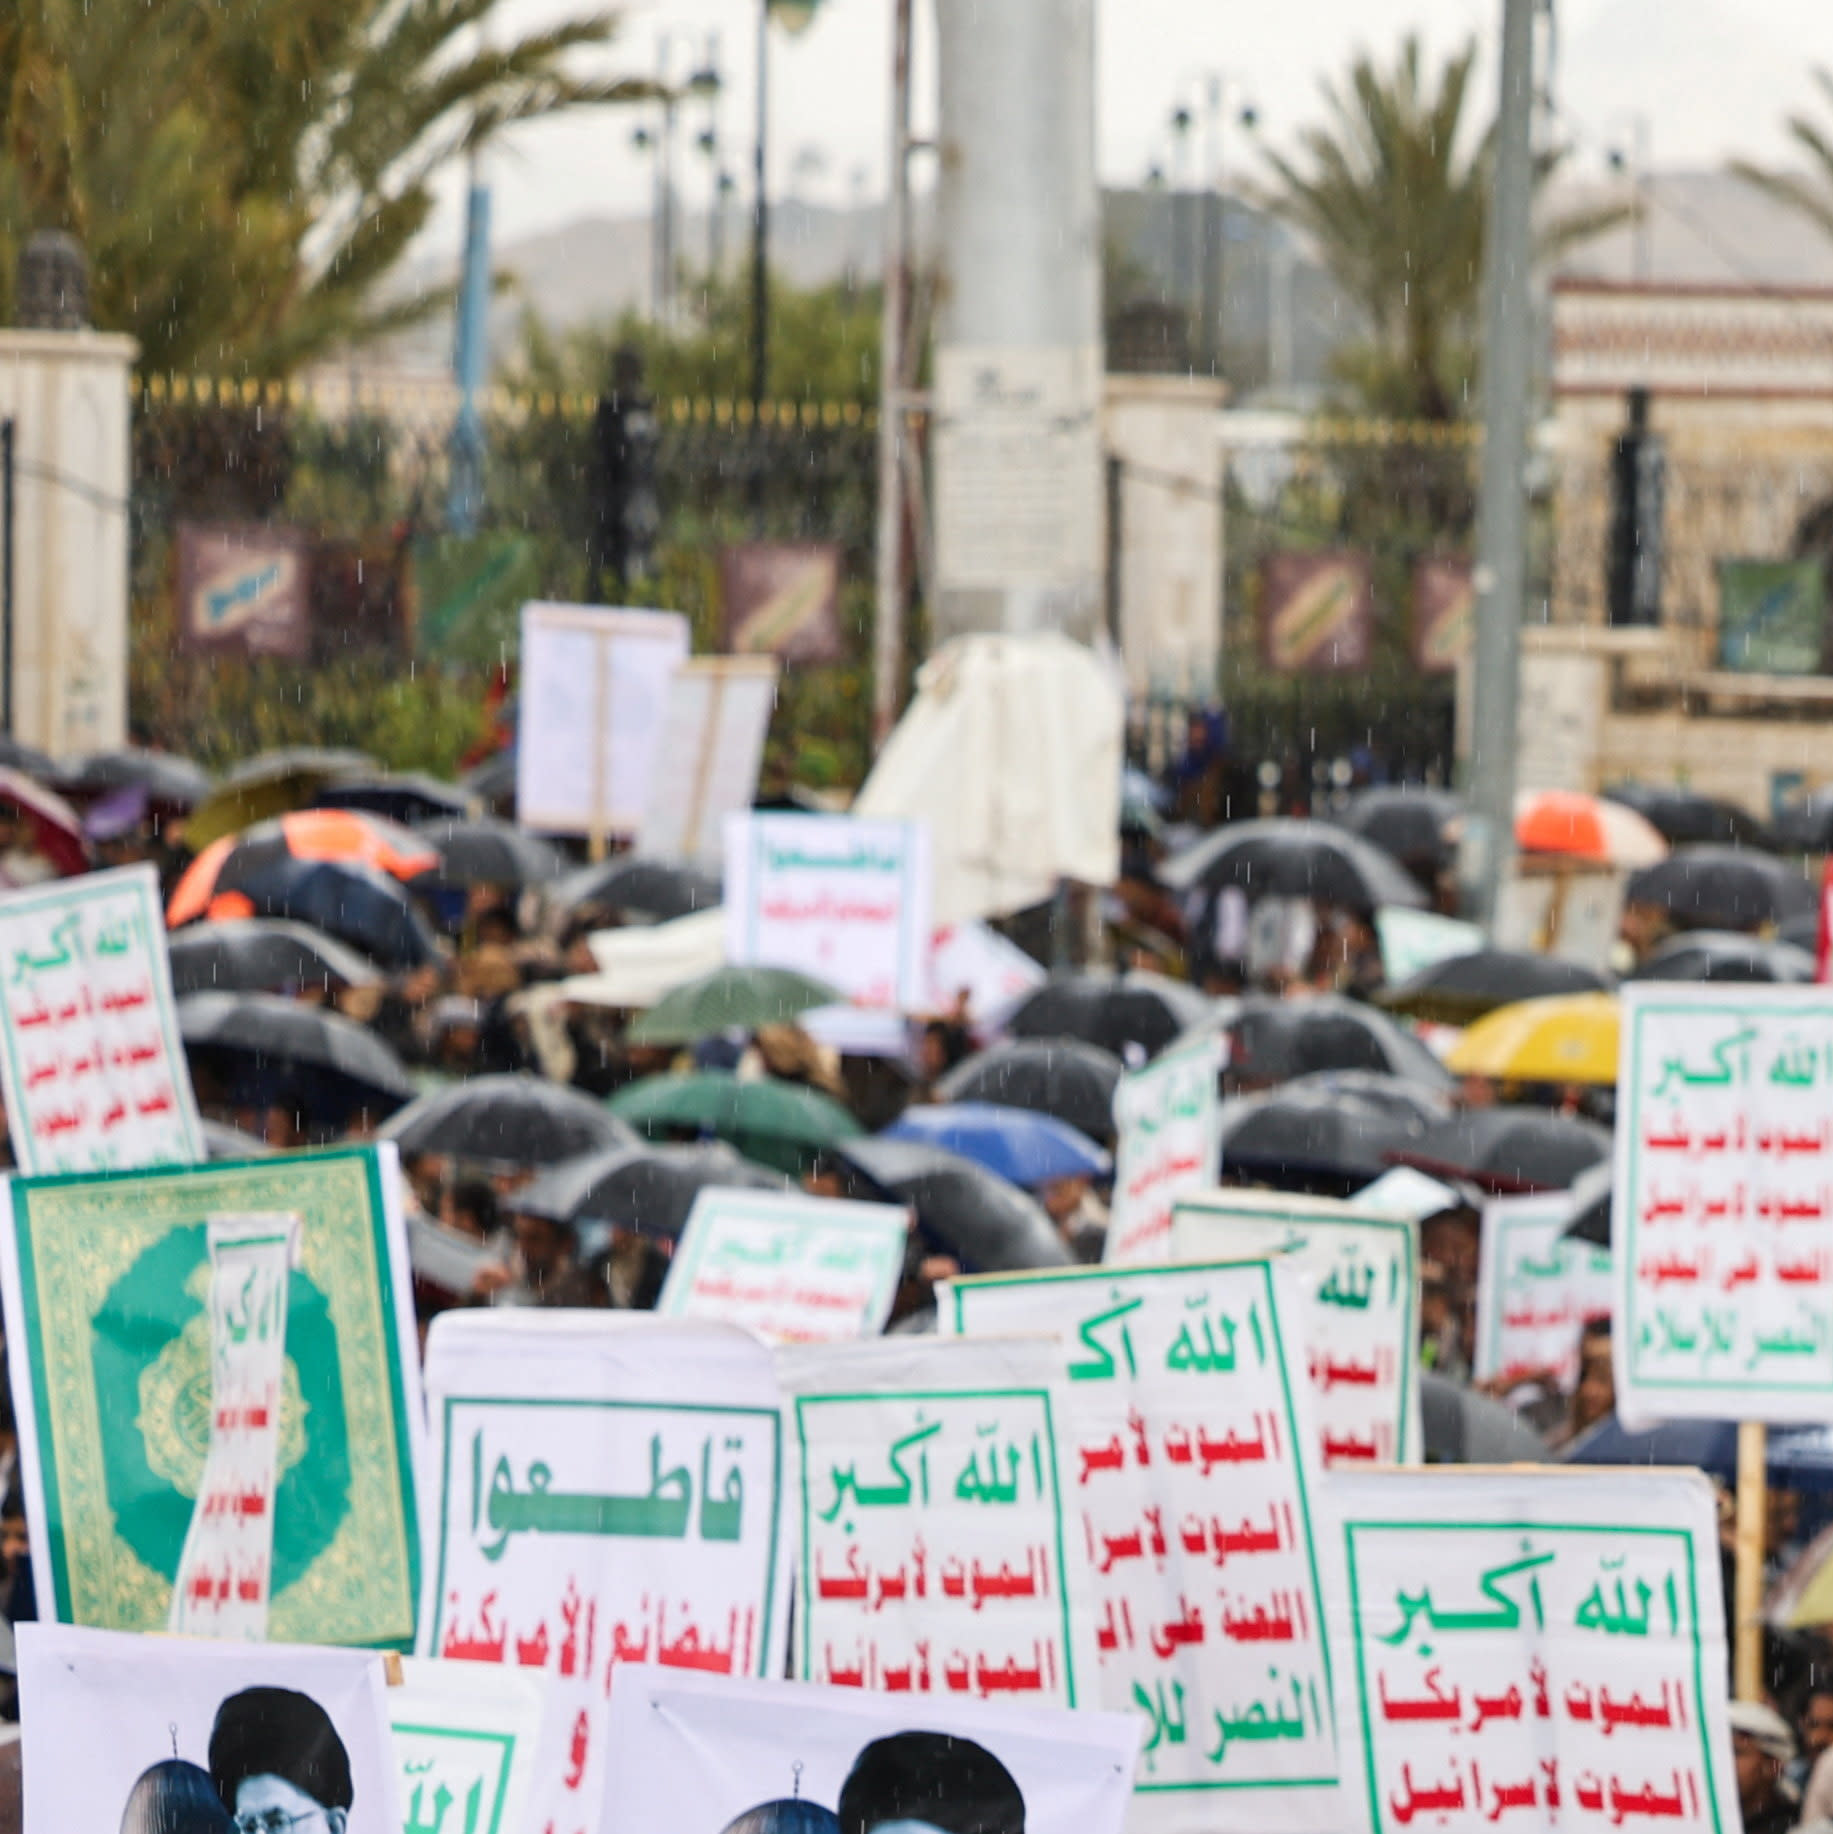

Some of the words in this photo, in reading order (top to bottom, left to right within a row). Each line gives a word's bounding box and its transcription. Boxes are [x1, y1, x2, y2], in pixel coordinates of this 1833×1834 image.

[1650, 1028, 1758, 1104] أكبر
[1316, 1248, 1400, 1312] الله
[1067, 1288, 1144, 1382] أك
[1165, 1296, 1267, 1374] الله
[818, 1413, 943, 1535] أكبر
[954, 1424, 1044, 1504] الله
[1077, 1408, 1153, 1487] لأمر
[1162, 1411, 1282, 1478] الموت
[472, 1430, 744, 1563] قاطعوا
[1085, 1506, 1170, 1576] لإسرا
[1178, 1502, 1297, 1568] الموت
[816, 1536, 929, 1613] لأمريكا
[940, 1546, 1050, 1613] الموت
[1376, 1540, 1557, 1659] أكبر
[1574, 1558, 1680, 1638] الله
[1149, 1596, 1207, 1662] على
[1220, 1592, 1308, 1644] اللعنة
[942, 1640, 1057, 1700] الموت
[1378, 1656, 1554, 1735] لأمريكا
[1206, 1667, 1321, 1765] النصر
[1563, 1680, 1688, 1737] الموت
[563, 1709, 590, 1792] و
[1388, 1757, 1563, 1827] لإسرائيل
[1573, 1768, 1700, 1828] الموت
